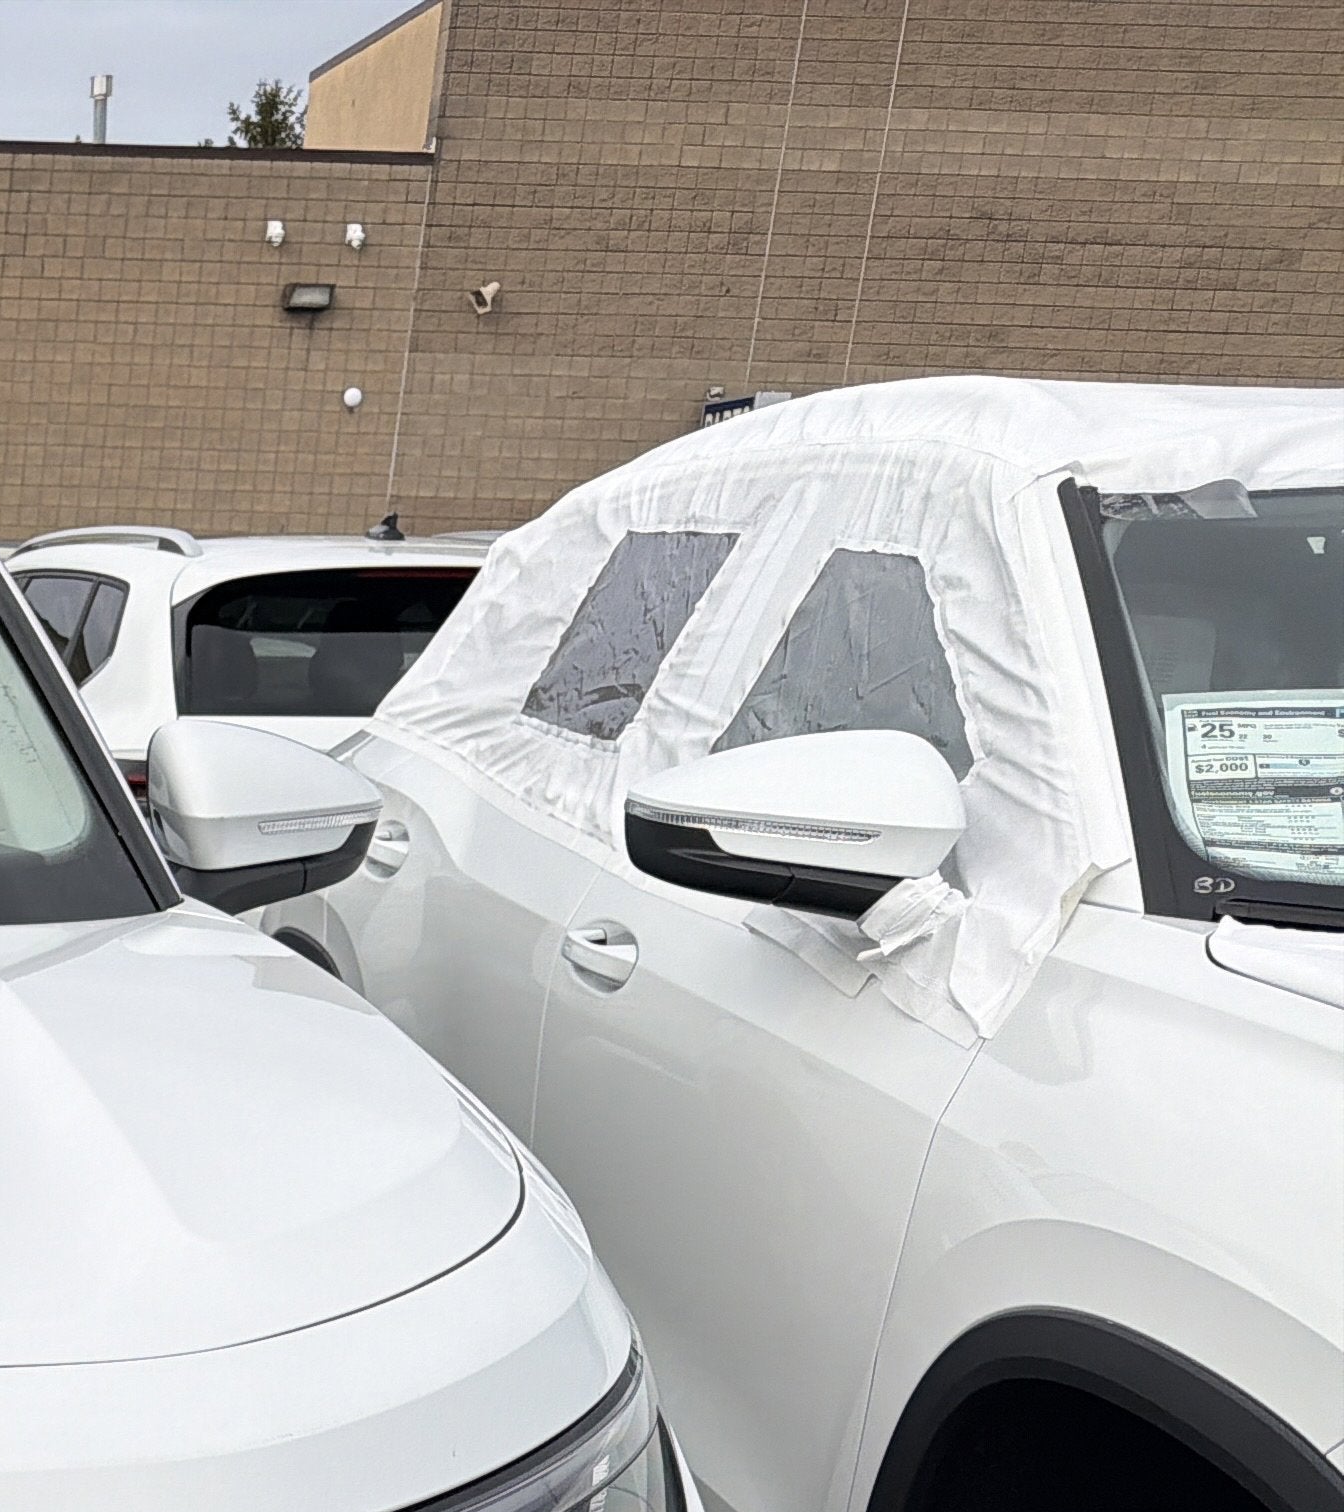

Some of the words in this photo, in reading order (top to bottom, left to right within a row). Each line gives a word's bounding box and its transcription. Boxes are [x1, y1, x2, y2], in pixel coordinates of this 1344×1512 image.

[1200, 722, 1236, 739] 25
[1195, 763, 1249, 774] $2,000
[1193, 876, 1236, 894] BD
